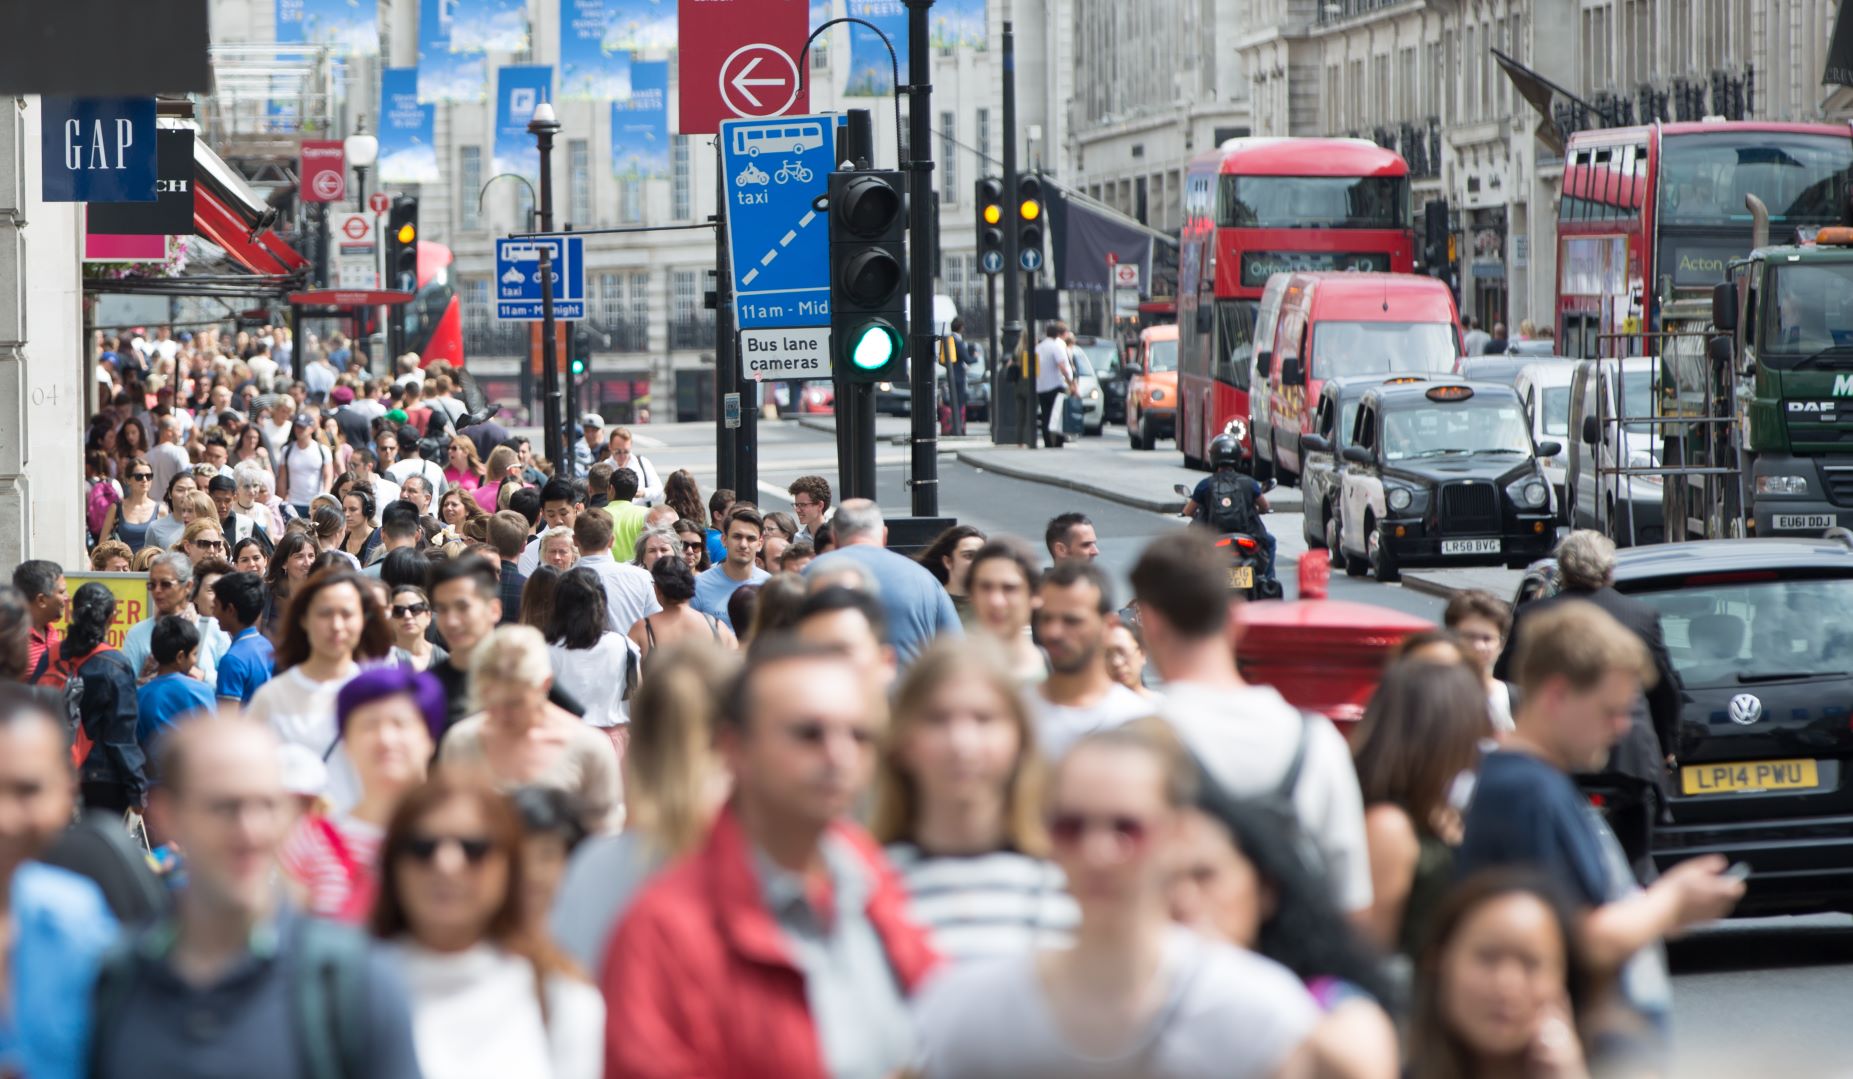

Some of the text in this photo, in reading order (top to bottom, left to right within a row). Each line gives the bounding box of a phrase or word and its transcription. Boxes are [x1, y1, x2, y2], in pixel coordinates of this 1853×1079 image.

[65, 118, 133, 170] GAP
[156, 179, 188, 192] CH
[737, 189, 769, 205] taxi
[1680, 255, 1723, 272] Acton
[502, 286, 522, 297] taxi
[533, 304, 580, 317] Mnight
[799, 301, 829, 316] Mid
[747, 337, 818, 352] Bus lane
[750, 356, 819, 371] cameras
[1788, 401, 1835, 412] DAF
[1808, 516, 1831, 527] DDJ
[1476, 539, 1496, 551] BVG
[1697, 763, 1802, 789] LP14 PWU
